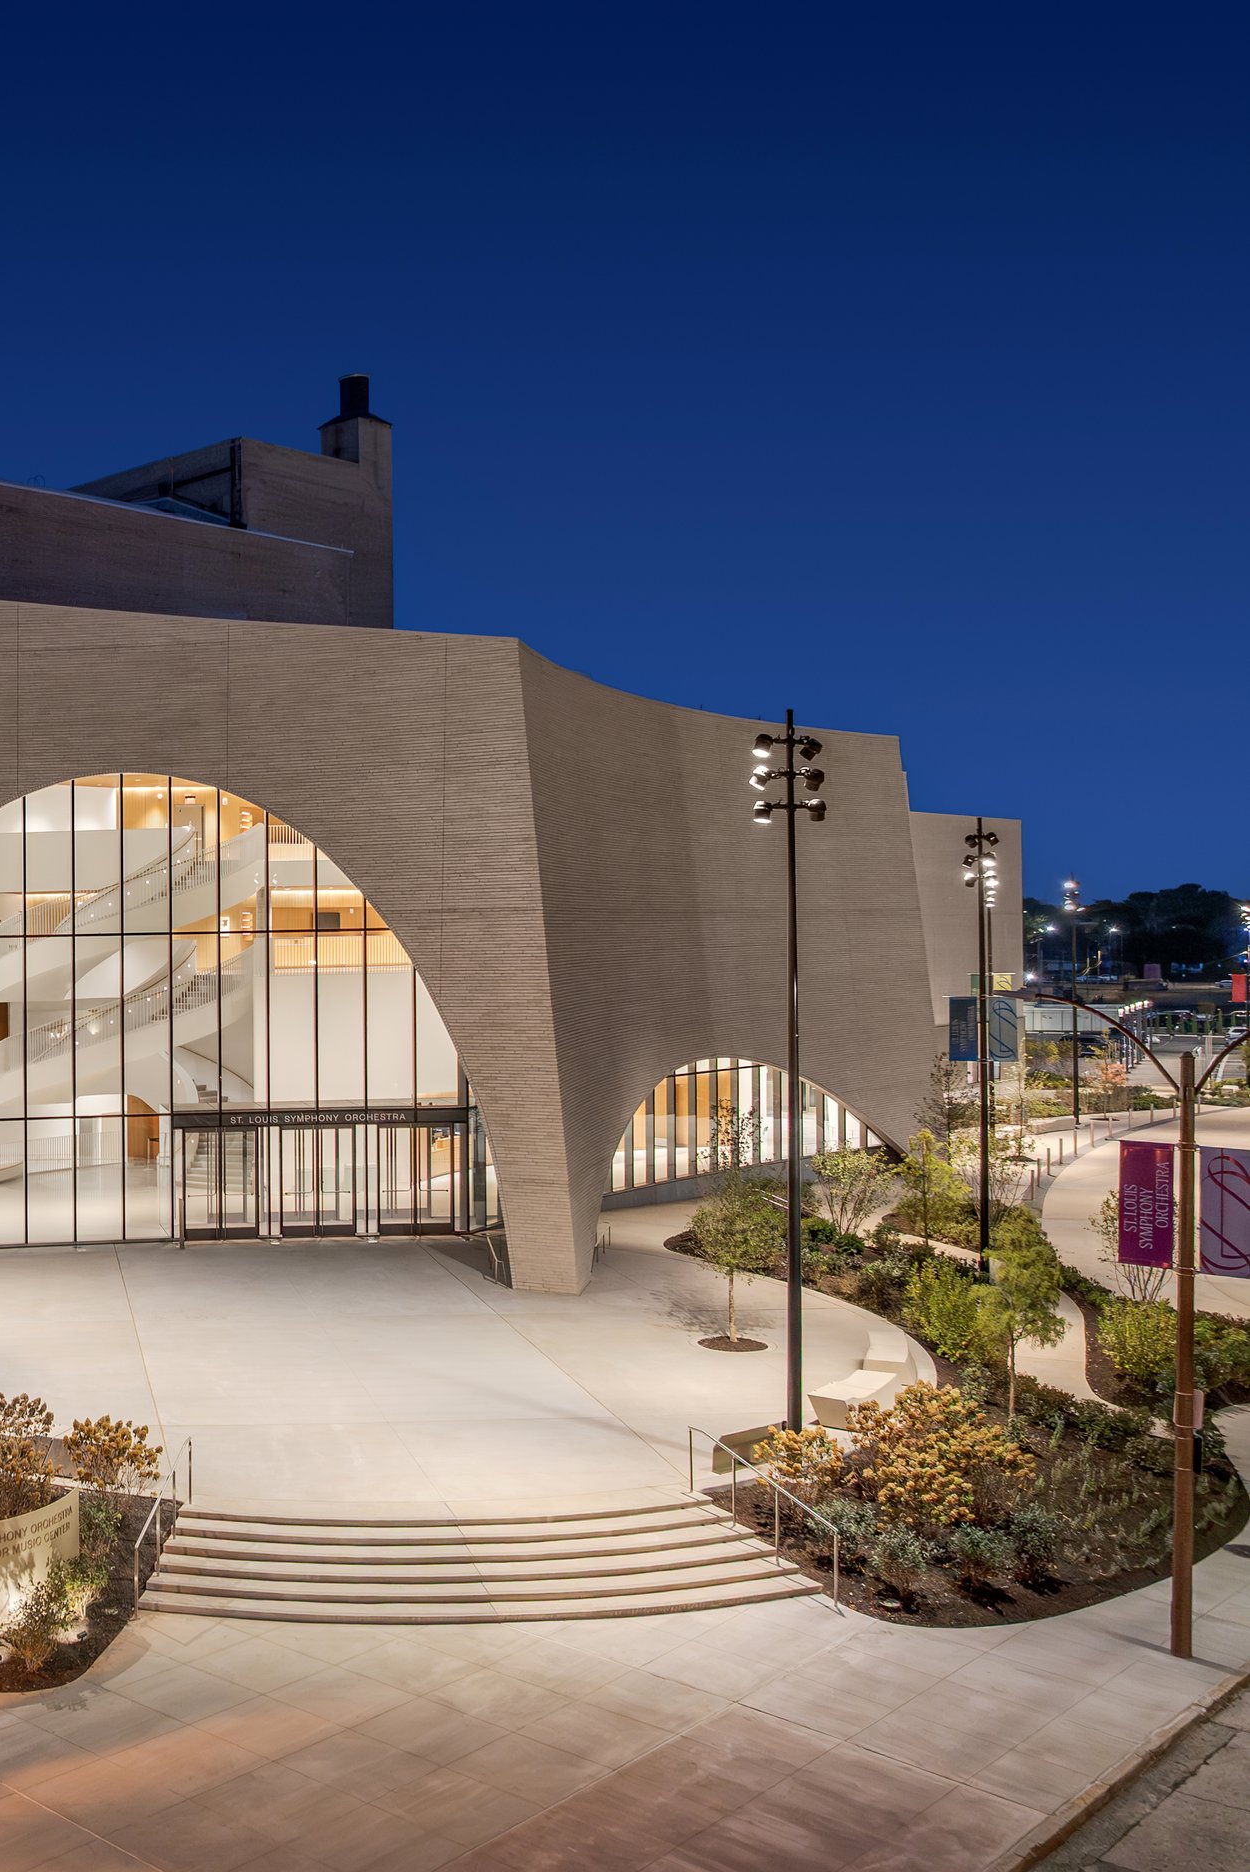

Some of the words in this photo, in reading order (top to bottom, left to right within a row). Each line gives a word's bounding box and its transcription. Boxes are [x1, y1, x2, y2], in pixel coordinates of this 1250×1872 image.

[230, 1115, 244, 1124] ST.
[249, 1115, 279, 1124] LOUIS
[284, 1114, 339, 1123] SYMPHONY
[345, 1112, 406, 1122] ORCHESTRA
[1124, 1184, 1137, 1216] LOUIS
[1155, 1161, 1169, 1229] ORCHESTRA
[1139, 1187, 1153, 1249] SYMPHONY
[30, 1505, 73, 1534] ORCHESTRA
[12, 1536, 42, 1555] MUSIC
[44, 1521, 70, 1543] CENTER
